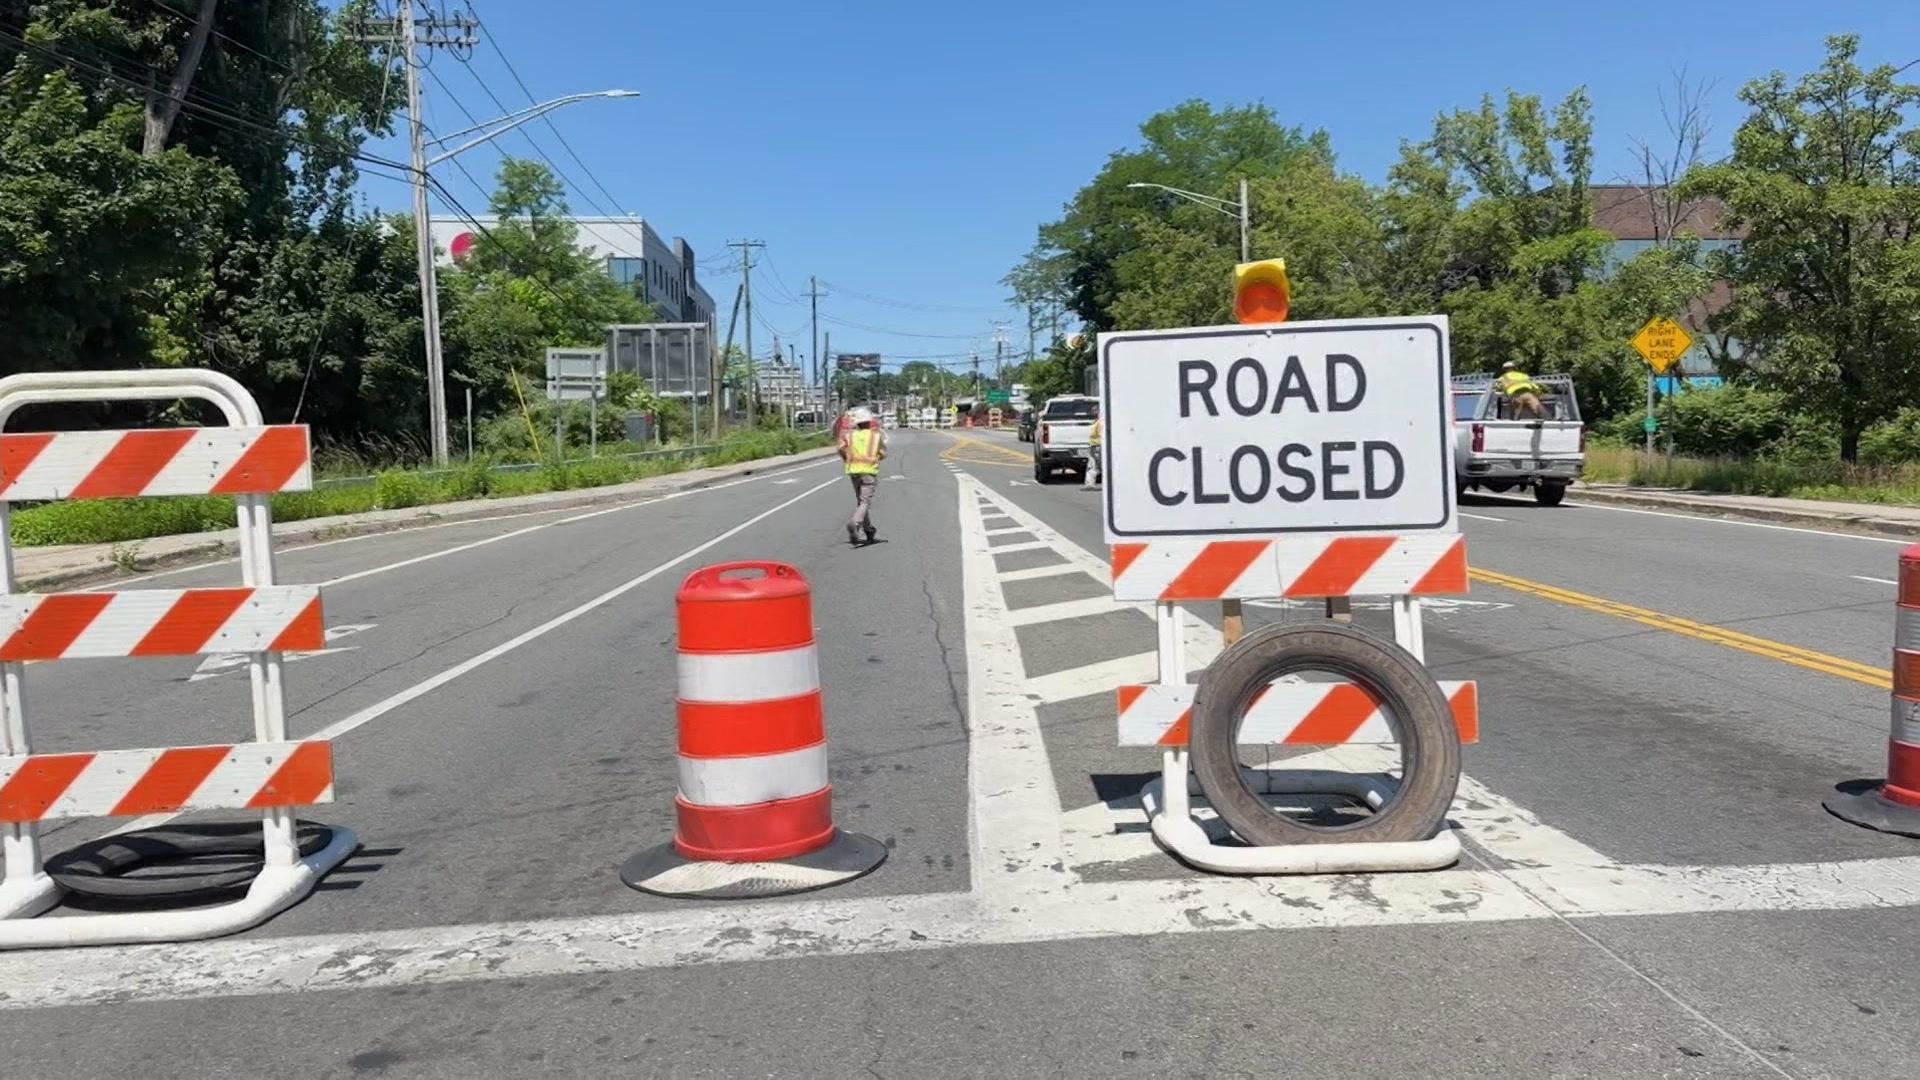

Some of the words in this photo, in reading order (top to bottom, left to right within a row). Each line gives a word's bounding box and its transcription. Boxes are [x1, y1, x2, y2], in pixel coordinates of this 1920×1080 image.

[1648, 327, 1676, 336] RIGHT
[1649, 339, 1675, 348] LANE
[1650, 350, 1676, 359] ENDS
[1179, 353, 1367, 418] ROAD
[1148, 441, 1404, 506] CLOSED
